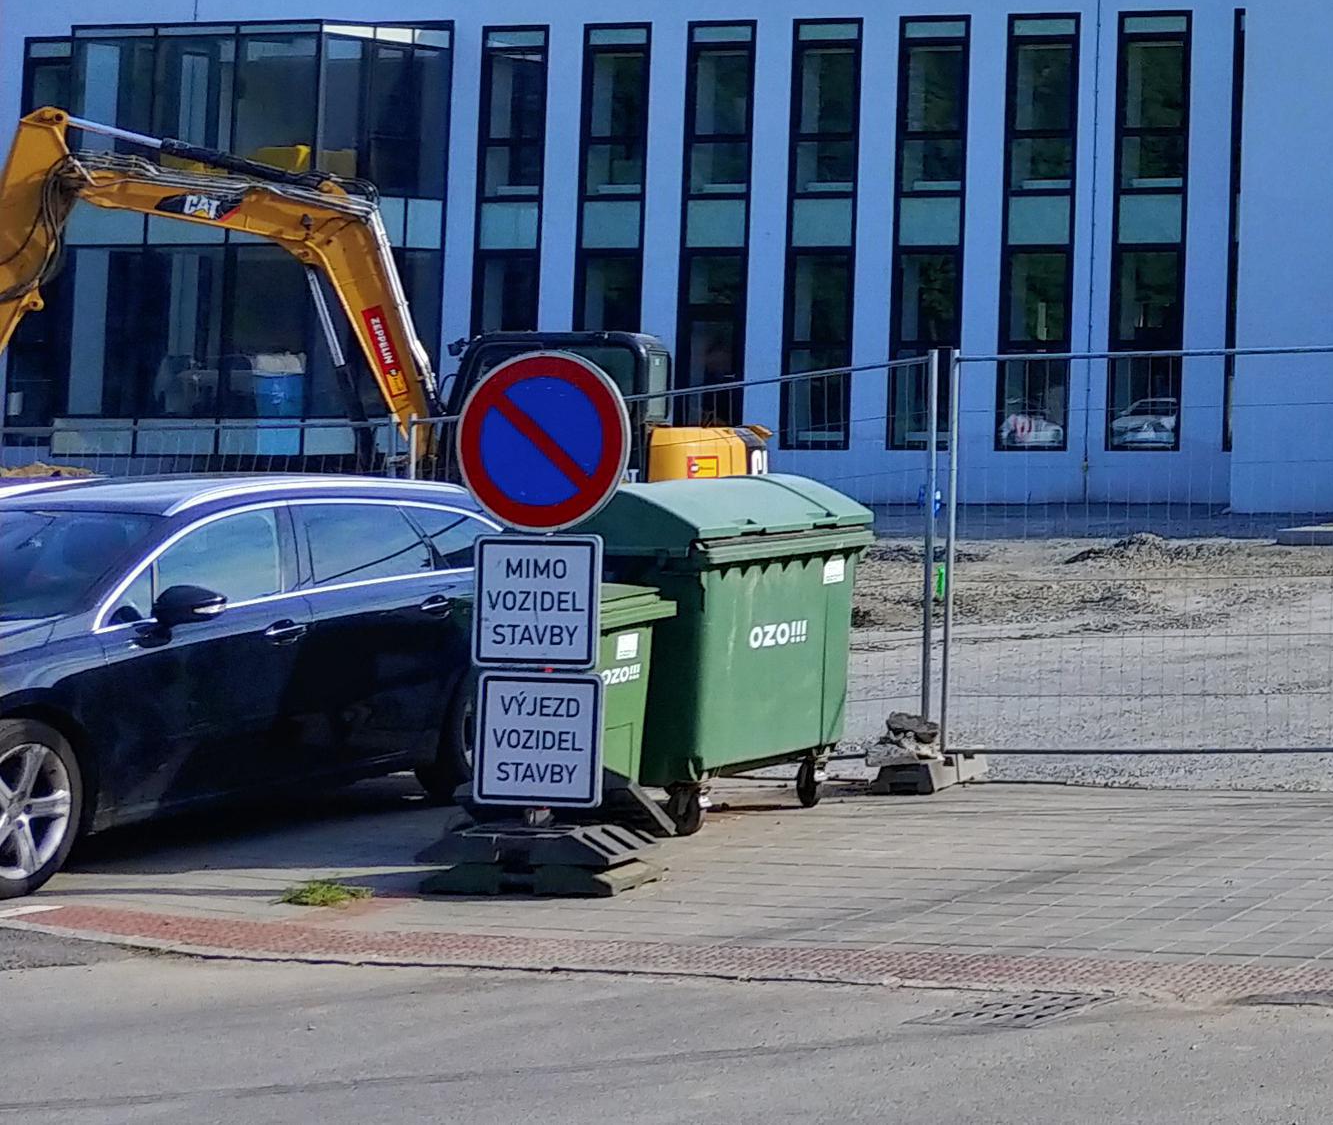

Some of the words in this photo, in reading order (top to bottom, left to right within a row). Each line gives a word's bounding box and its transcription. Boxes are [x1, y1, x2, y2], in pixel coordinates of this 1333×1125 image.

[184, 194, 219, 219] CAT
[370, 316, 394, 365] ZEPPELIN
[505, 558, 567, 579] MIMO
[487, 590, 585, 612] VOZIDEL
[491, 624, 578, 646] STAVBY
[749, 620, 808, 648] OZO!!!
[500, 691, 581, 718] VÝJEZD
[492, 728, 584, 752] VOZIDEL
[496, 761, 578, 785] STAVBY
